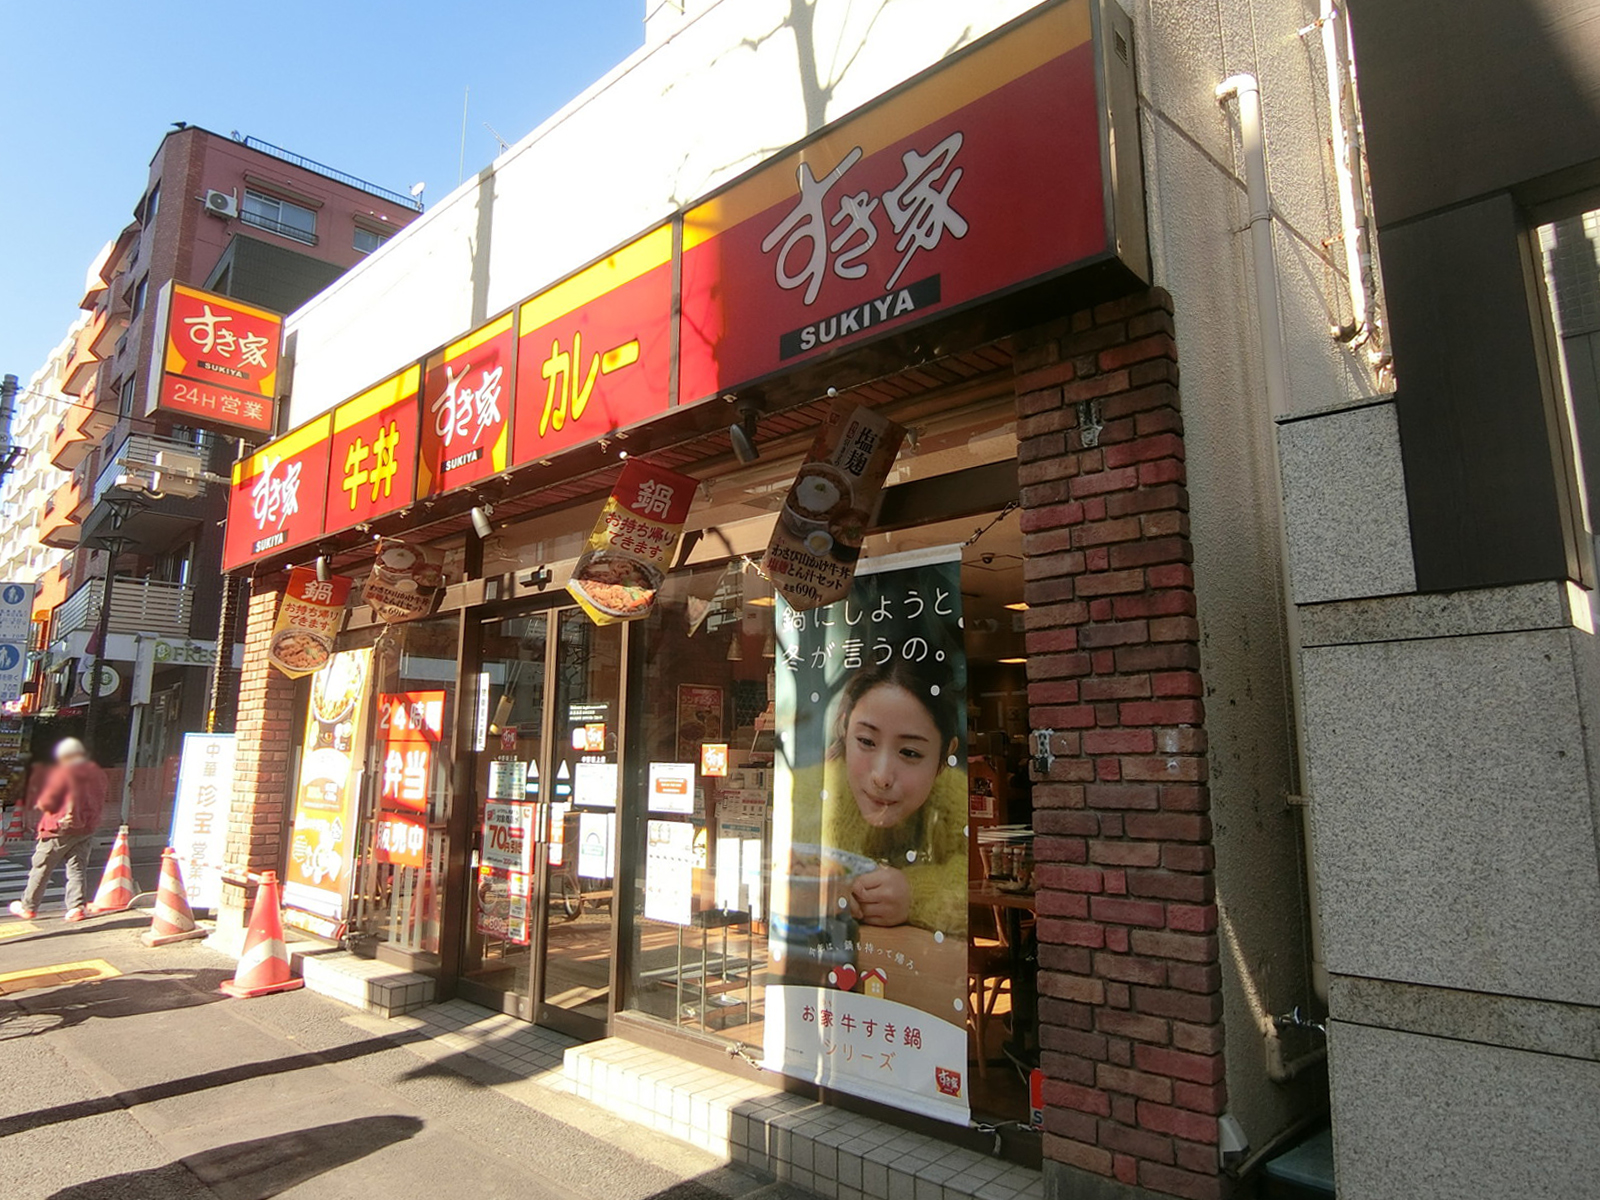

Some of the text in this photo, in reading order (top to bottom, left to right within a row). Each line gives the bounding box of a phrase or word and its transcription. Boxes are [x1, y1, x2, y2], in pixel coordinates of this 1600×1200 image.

[761, 130, 970, 306] すき家
[183, 304, 269, 369] すき家
[799, 288, 915, 351] SUKIYA
[204, 362, 243, 378] SUKIYA
[539, 330, 640, 438] カレー
[431, 363, 503, 447] すき家
[342, 419, 400, 511] 牛丼
[445, 450, 478, 471] SUKIYA
[252, 454, 302, 530] すき家
[631, 479, 674, 519] 鍋
[255, 532, 284, 553] SUKIYA
[605, 511, 677, 547] お持ち帰り
[608, 530, 664, 562] できます。
[284, 602, 339, 621] お持ち帰り
[301, 579, 334, 604] 鍋
[782, 588, 953, 632] 鍋にしようと
[288, 614, 332, 632] できます。
[781, 636, 946, 672] 冬が言うの。
[382, 749, 427, 799] 弁当
[802, 1004, 923, 1050] お家牛すき鍋
[823, 1039, 897, 1072] シリーズ
